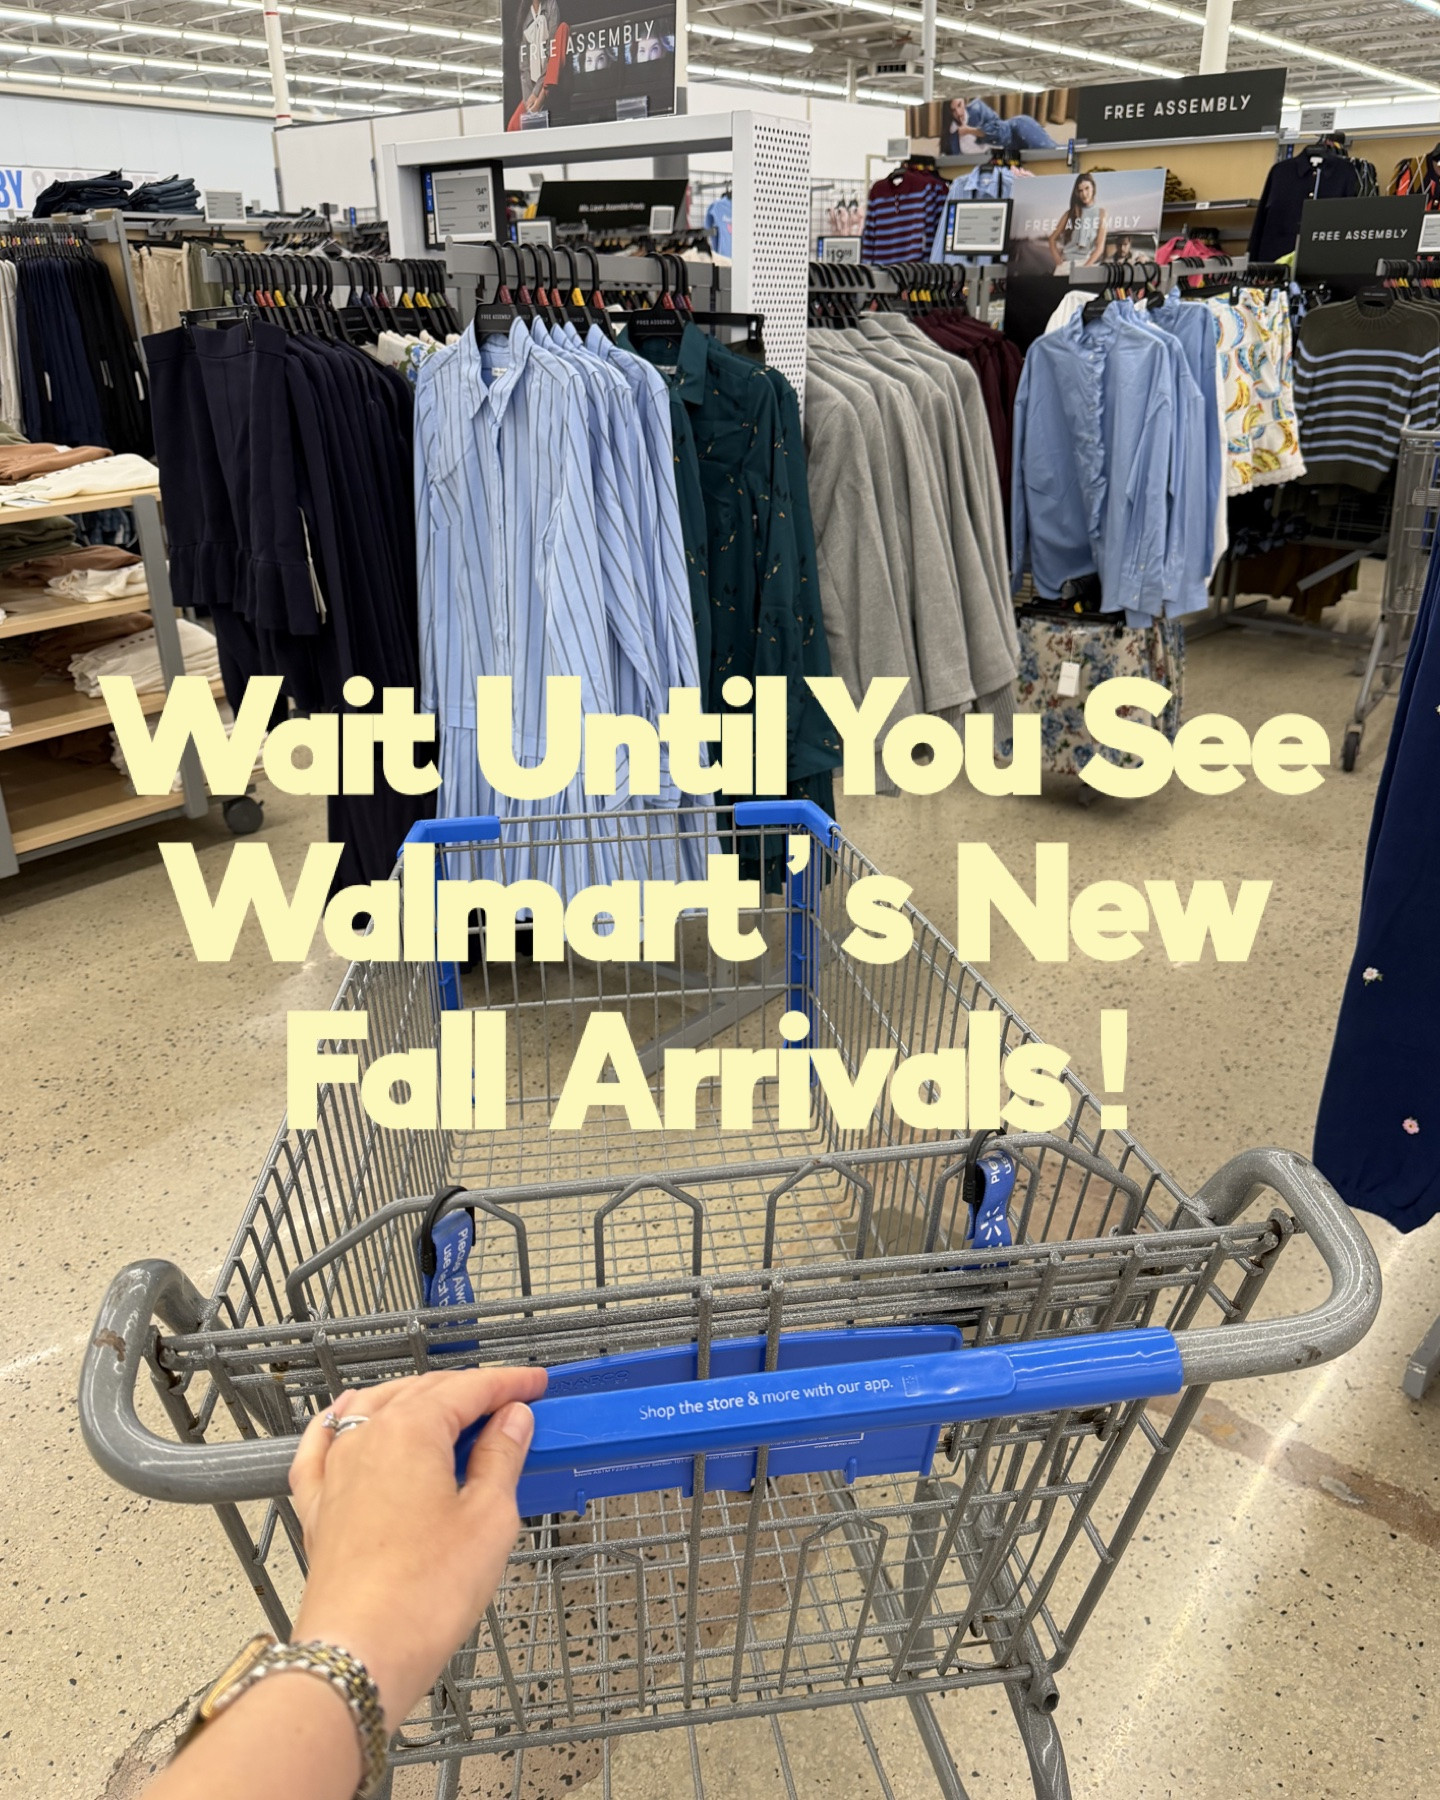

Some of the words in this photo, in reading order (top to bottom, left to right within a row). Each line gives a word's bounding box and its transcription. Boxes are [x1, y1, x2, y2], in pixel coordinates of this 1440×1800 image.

[520, 39, 557, 63] FREE
[566, 20, 654, 55] ASSEMBLY
[1104, 103, 1145, 120] FREE
[1154, 94, 1251, 117] ASSEMBLY
[1024, 220, 1058, 231] FREE
[1065, 215, 1141, 230] ASSEMBLY
[1312, 231, 1340, 241] FREE
[1345, 229, 1408, 240] ASSEMBLY
[988, 1161, 1000, 1184] Ple
[548, 1369, 630, 1393] UNARCO
[639, 1405, 676, 1420] Shop
[679, 1400, 704, 1415] the
[706, 1396, 744, 1412] store
[747, 1391, 760, 1406] &
[762, 1389, 800, 1403] more
[802, 1382, 834, 1398] with
[836, 1381, 860, 1394] our
[864, 1378, 894, 1393] app.
